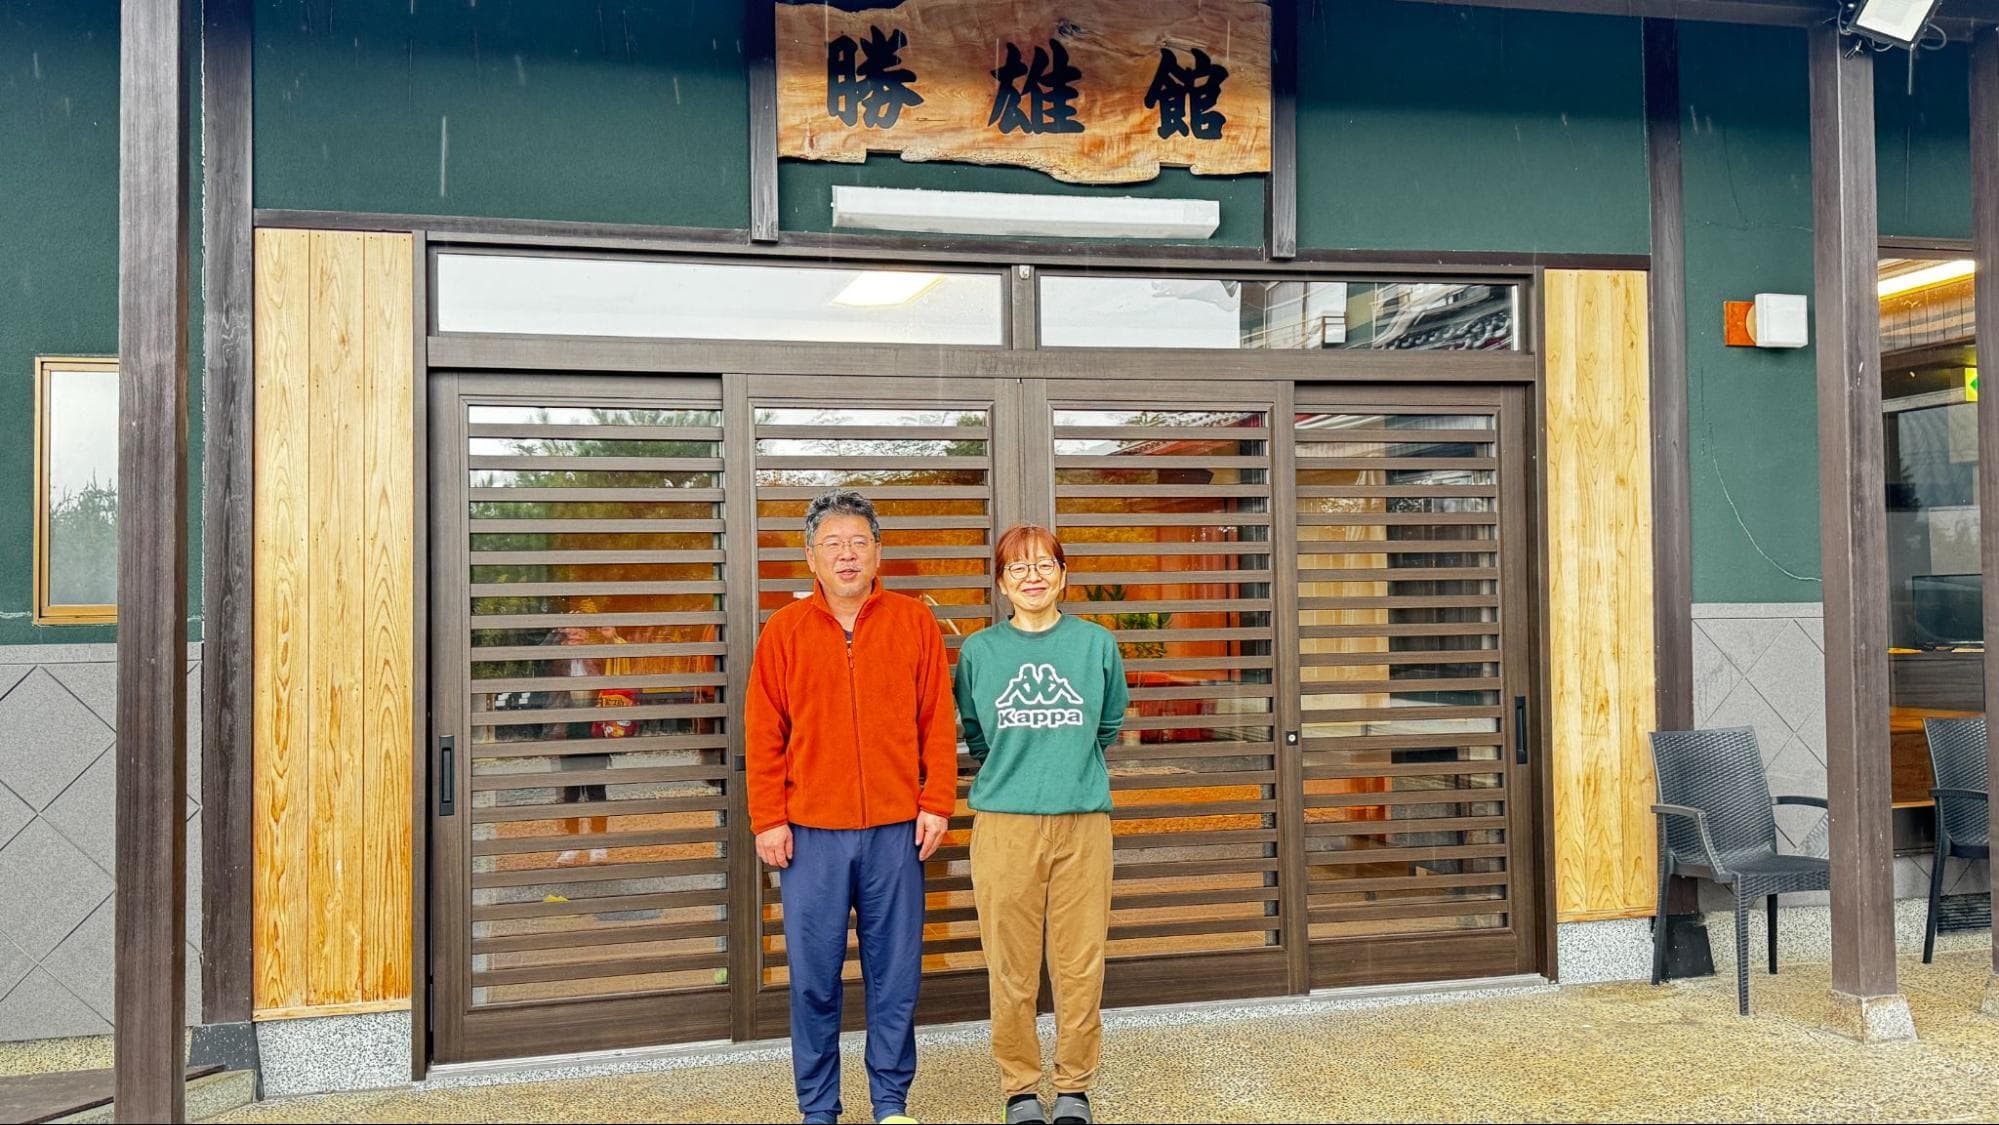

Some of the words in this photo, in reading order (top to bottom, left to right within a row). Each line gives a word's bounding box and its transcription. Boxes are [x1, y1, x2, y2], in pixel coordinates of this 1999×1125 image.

[826, 25, 1230, 140] 勝雄館
[997, 708, 1083, 728] Kappa
